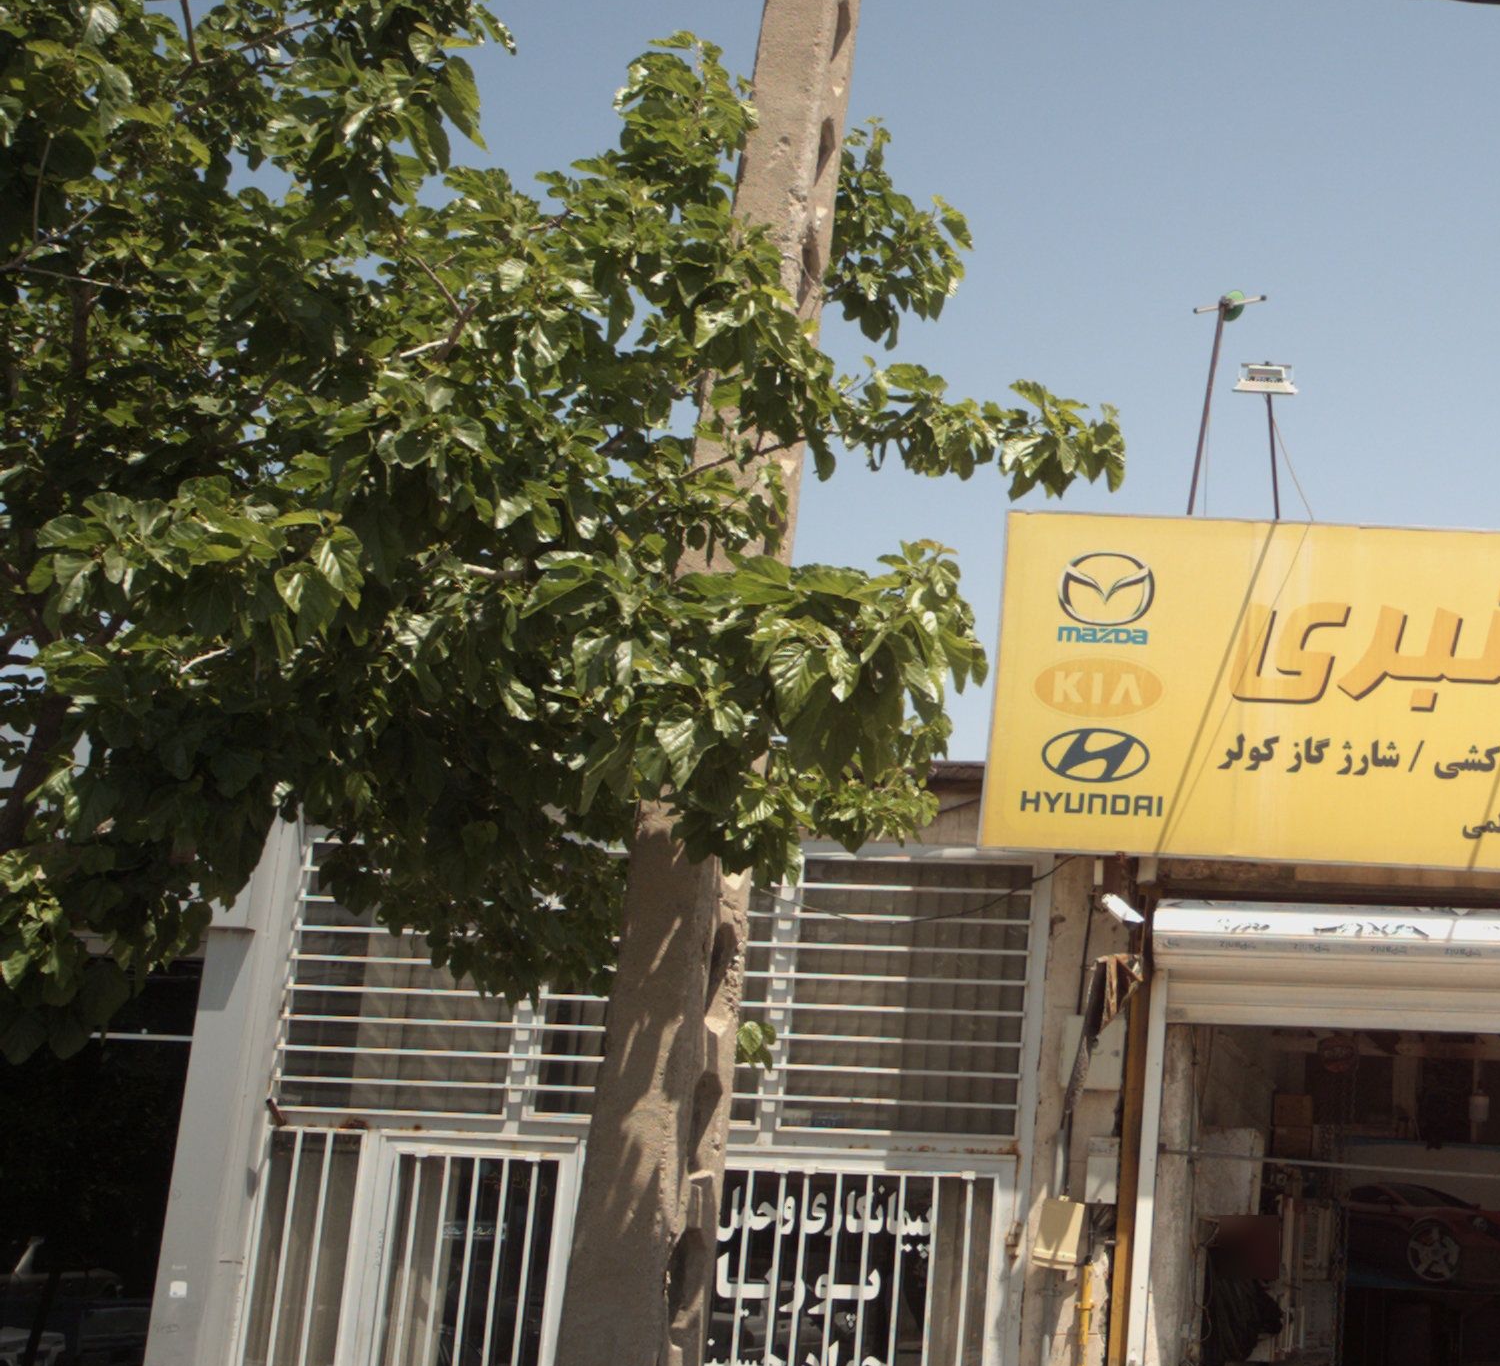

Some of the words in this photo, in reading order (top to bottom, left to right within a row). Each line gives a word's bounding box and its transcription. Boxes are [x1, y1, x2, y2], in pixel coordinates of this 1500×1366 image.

[1052, 670, 1144, 707] KIA
[1216, 731, 1280, 771] کولر
[1286, 736, 1331, 774] گاز
[1336, 740, 1401, 776] شارژ
[1019, 790, 1164, 818] HYUNDAI
[802, 1184, 934, 1259] پیمانکاری
[715, 1250, 882, 1331] پوریا
